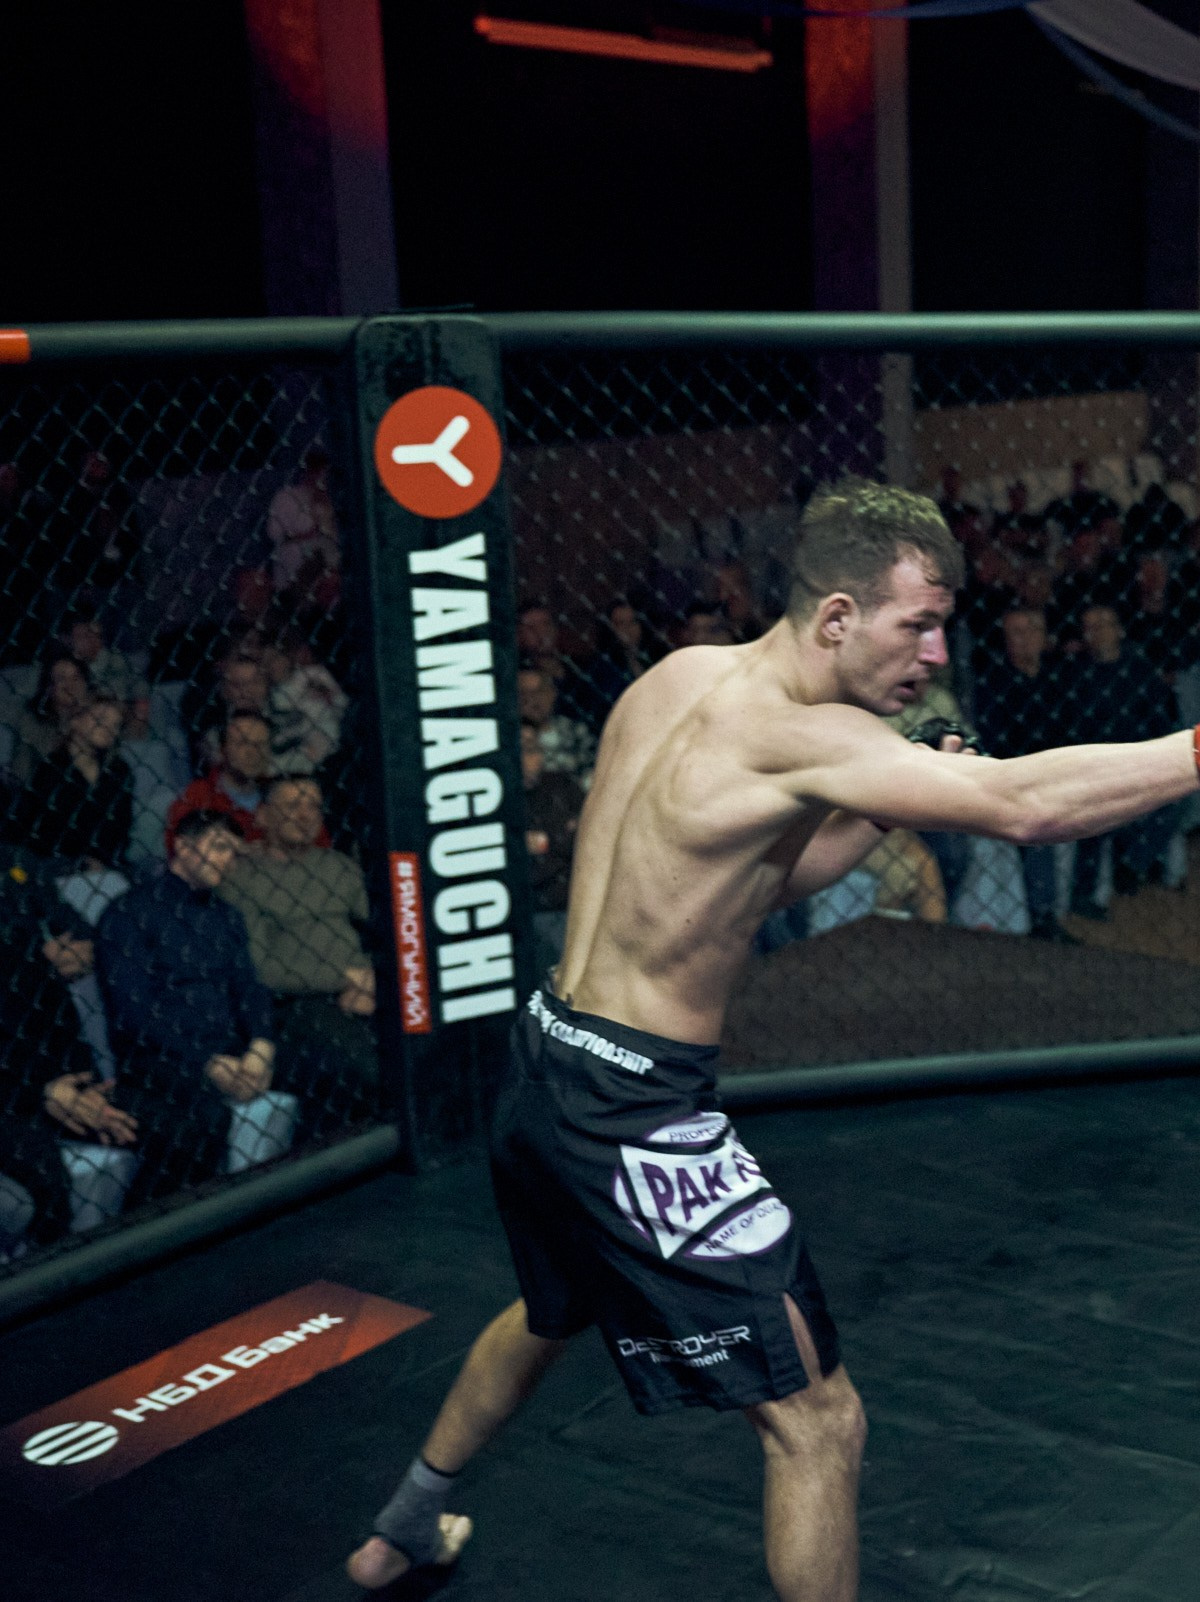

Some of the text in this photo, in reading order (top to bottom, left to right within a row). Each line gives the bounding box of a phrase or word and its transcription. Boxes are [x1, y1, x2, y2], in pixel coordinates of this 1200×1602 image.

[408, 532, 516, 1024] YAMAGUCHI
[639, 1160, 733, 1237] PAK
[111, 1312, 345, 1423] НБД Банк
